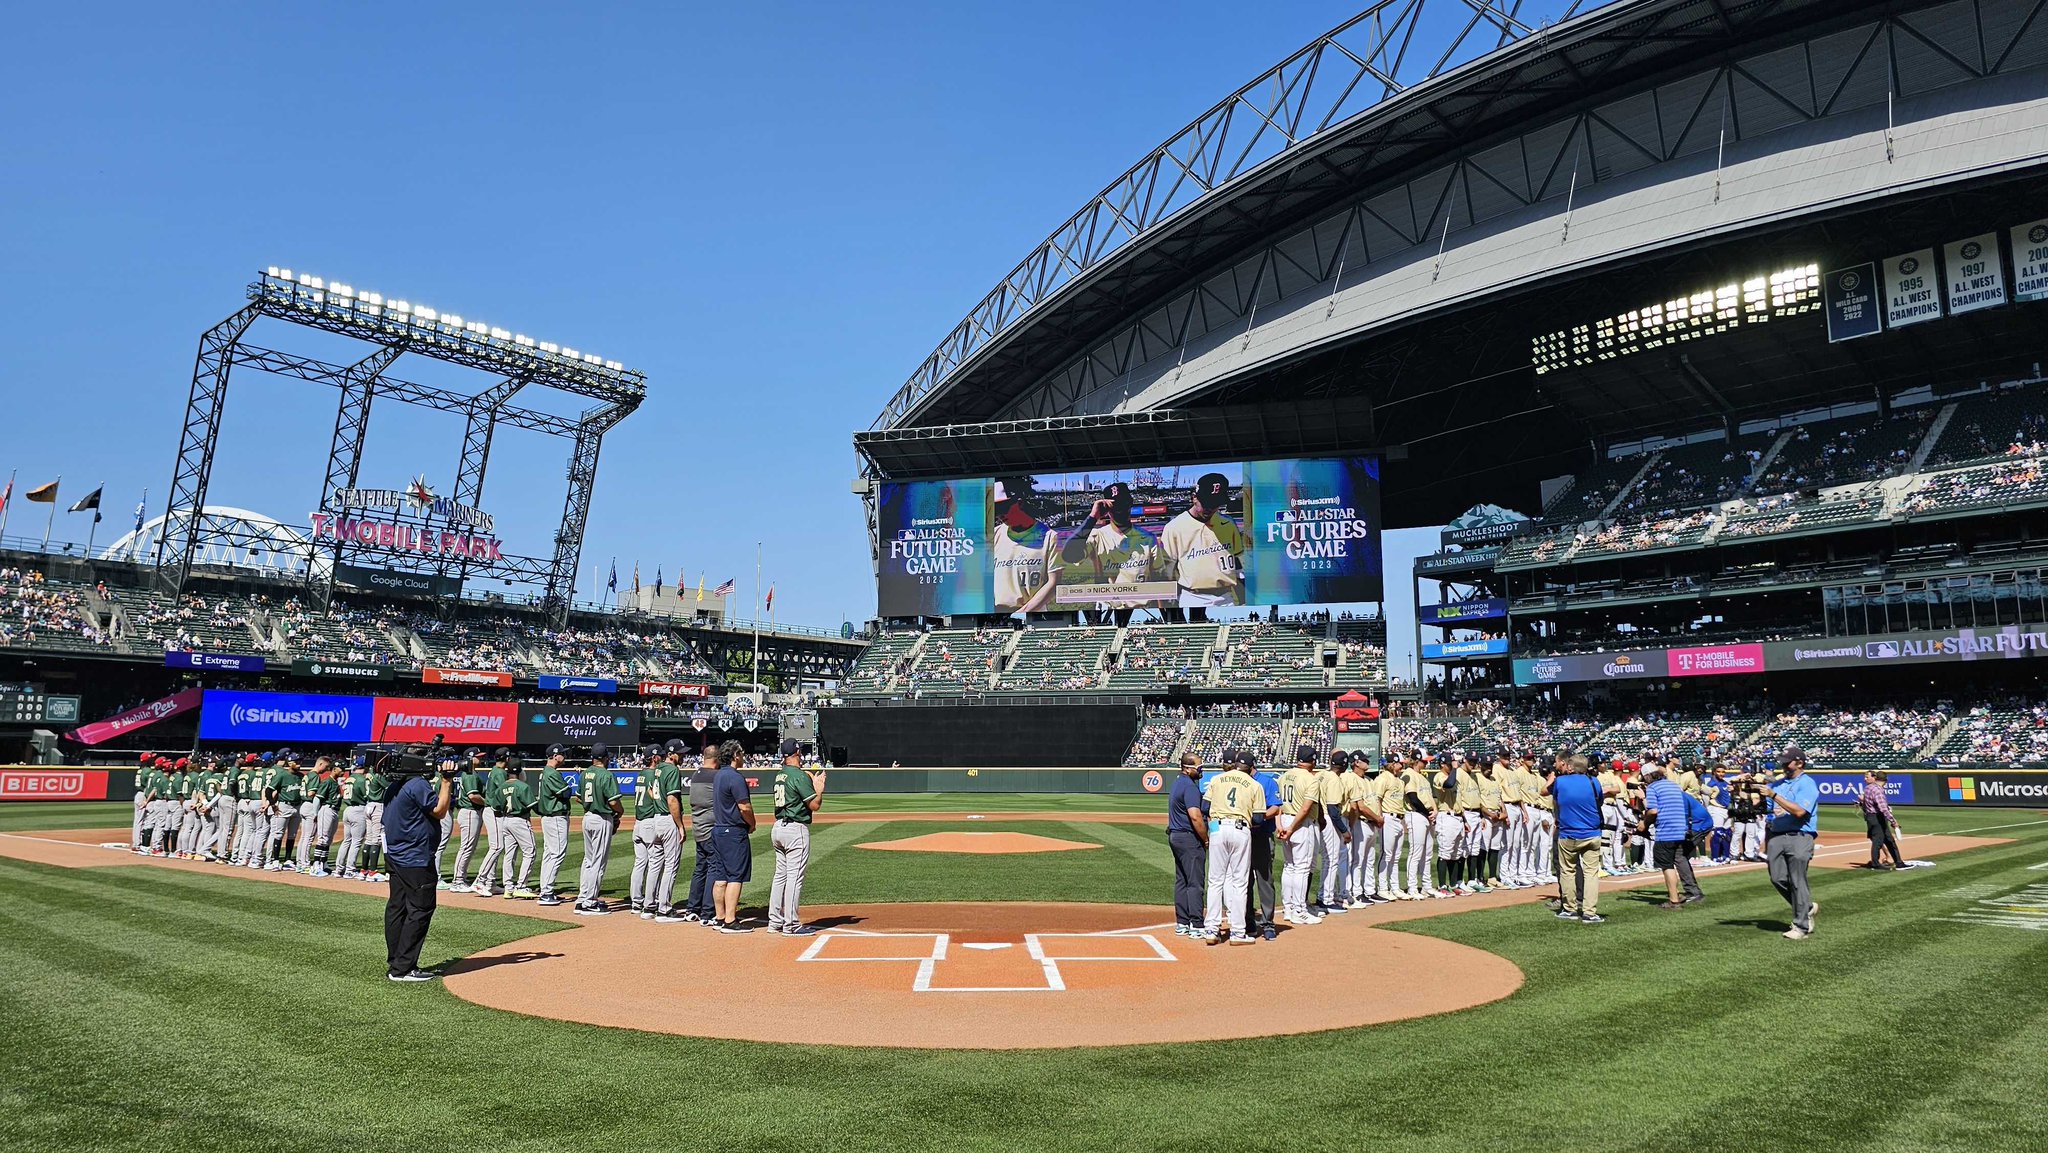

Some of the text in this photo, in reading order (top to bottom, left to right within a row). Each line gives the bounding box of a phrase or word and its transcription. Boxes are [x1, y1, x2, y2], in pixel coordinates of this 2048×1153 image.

[1961, 262, 1985, 277] 1997
[2022, 265, 2038, 278] A.L.
[1899, 276, 1923, 292] 1995
[1955, 275, 1995, 293] A.L. WEST
[1852, 295, 1868, 304] CARD
[1893, 289, 1931, 307] A.L. WEST
[1951, 287, 2002, 308] CHAMPIONS
[1843, 304, 1861, 313] 2000
[1844, 311, 1862, 320] 2022
[1890, 302, 1938, 321] CHAMPIONS
[332, 487, 400, 508] SEATTLE
[432, 496, 494, 531] MARINERS
[310, 512, 503, 561] T-MOBILE PARK
[1267, 520, 1367, 542] FUTURES
[1452, 523, 1519, 539] MUCKLESHOOT
[891, 539, 974, 559] FUTURES
[1187, 543, 1232, 560] American
[1286, 540, 1347, 559] GAME
[906, 557, 957, 574] GAME
[1219, 555, 1235, 571] 10
[1303, 560, 1332, 569] 2023
[1464, 553, 1486, 564] WEEK
[370, 574, 429, 589] Google Cloud
[919, 575, 944, 584] 2023
[1020, 571, 1041, 587] 18
[205, 656, 240, 665] Extreme
[1695, 651, 1735, 661] T-MOBILE
[1695, 658, 1755, 669] FOR BUSINESS
[324, 666, 379, 676] STARBUCKS
[1603, 662, 1645, 677] Corona
[121, 711, 152, 727] Mobile
[549, 713, 612, 726] CASAMIGOS
[721, 720, 730, 728] 24
[563, 727, 597, 738] Tequila
[7, 777, 78, 791] BECU
[1146, 775, 1159, 786] 76
[1219, 775, 1251, 788] REYNOLDS
[585, 781, 594, 802] 2
[1282, 784, 1294, 803] 10
[1818, 782, 1865, 795] OBAL
[1227, 787, 1236, 808] 4
